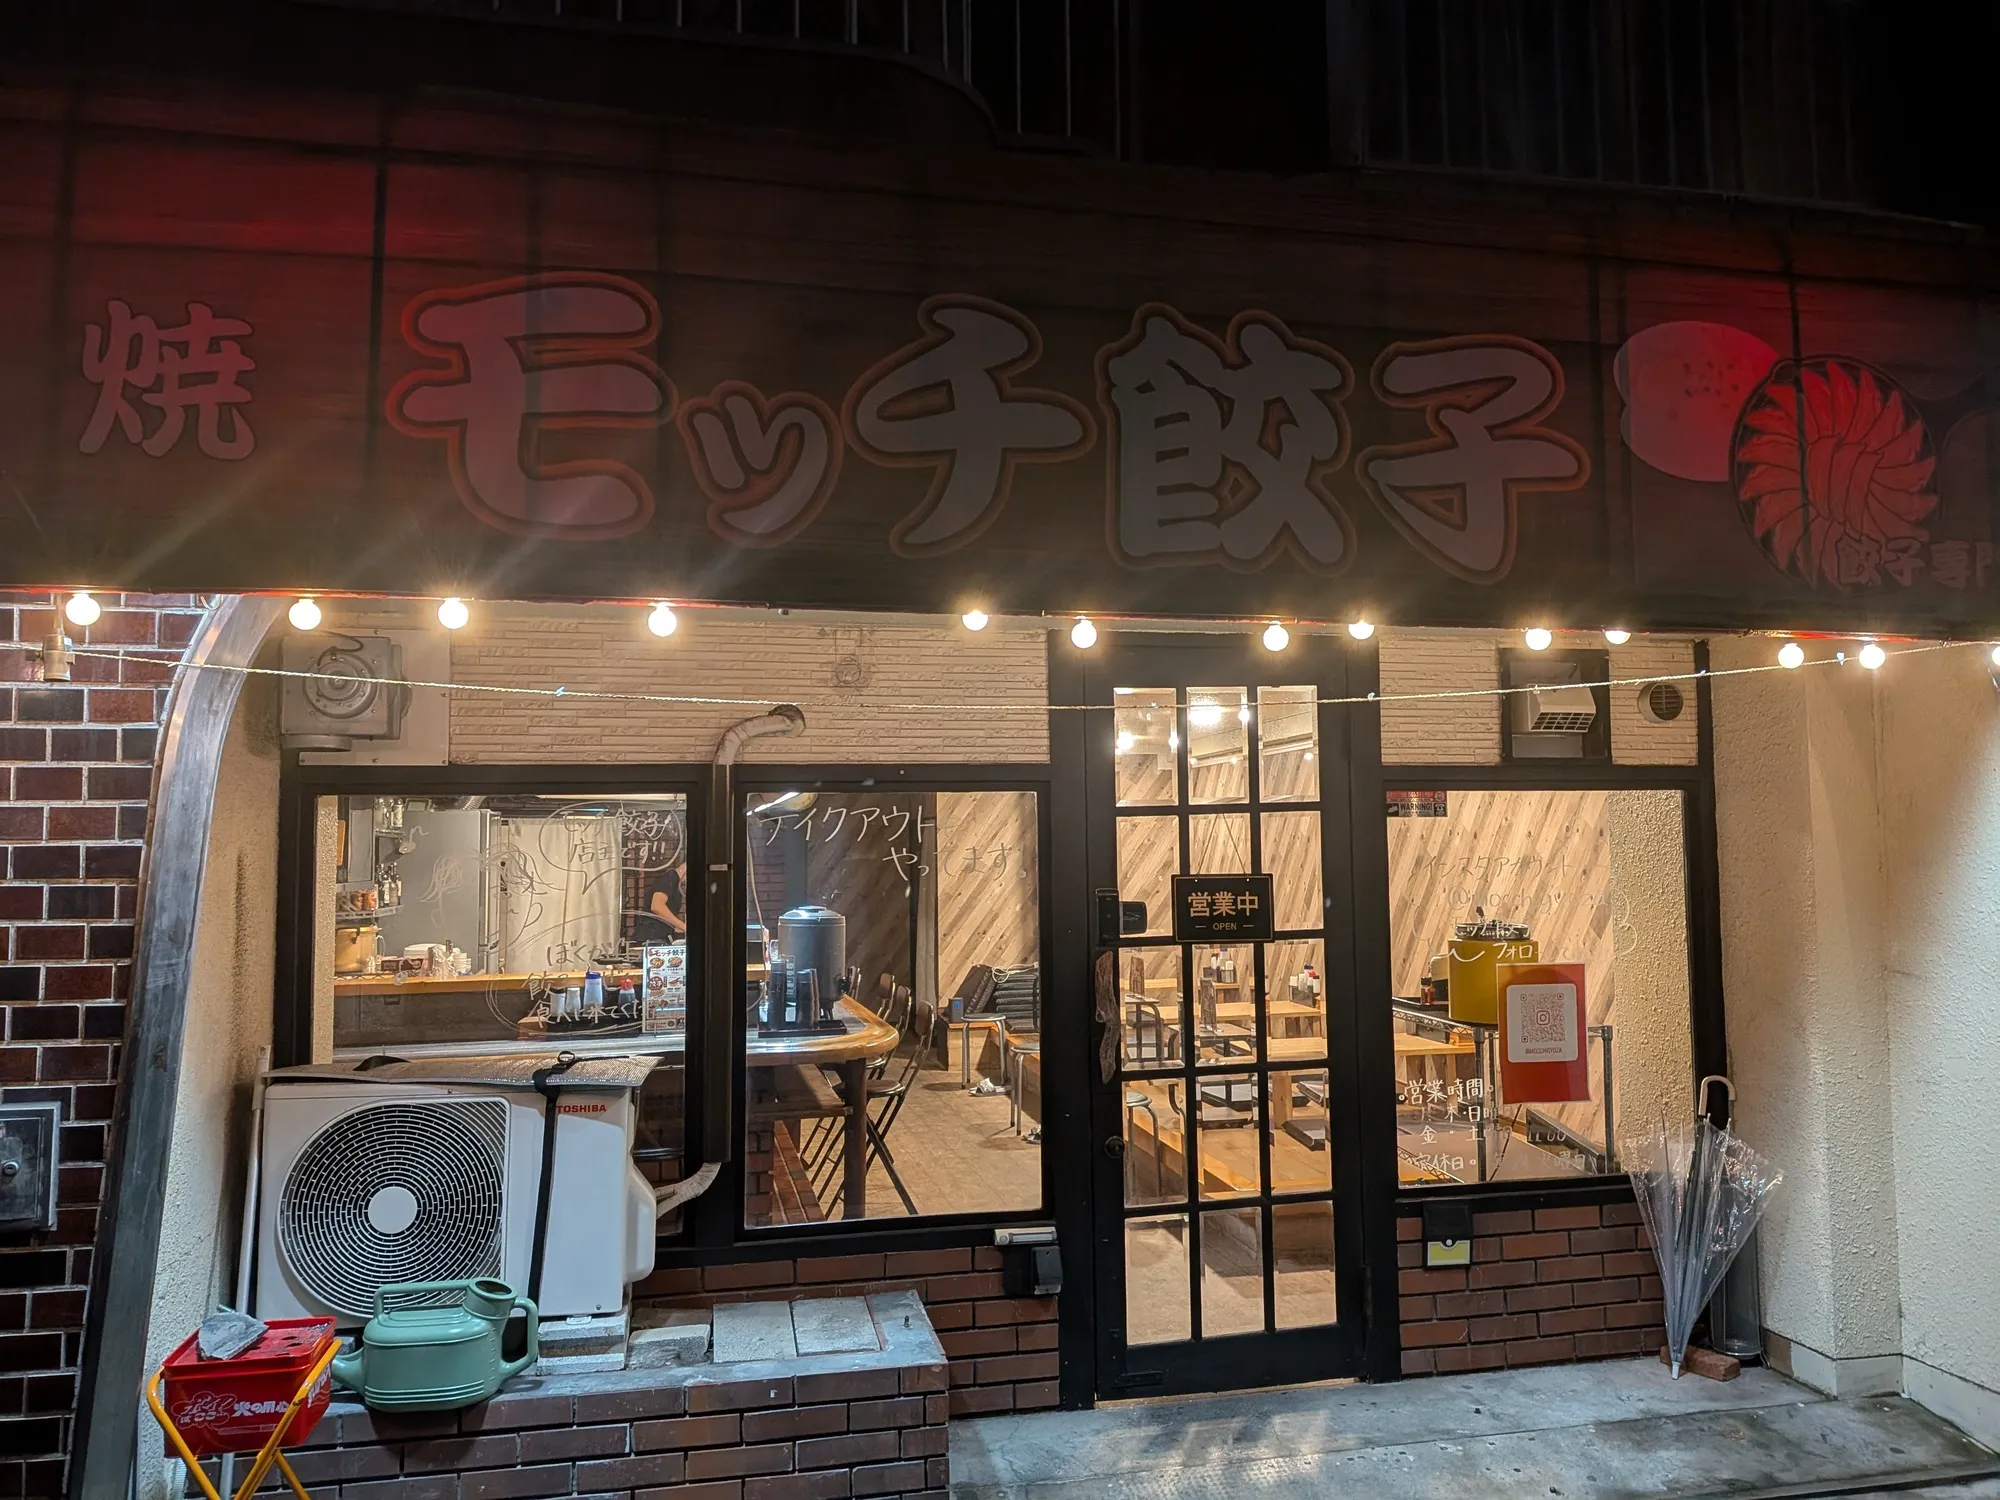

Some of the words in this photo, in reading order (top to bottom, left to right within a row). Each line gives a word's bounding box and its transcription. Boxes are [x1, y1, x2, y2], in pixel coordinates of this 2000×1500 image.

[79, 300, 257, 460] 焼
[386, 271, 1590, 585] モッチ餃子
[1188, 890, 1259, 918] 営業中
[1212, 921, 1238, 932] OPEN
[556, 1104, 607, 1114] TOSHIBA
